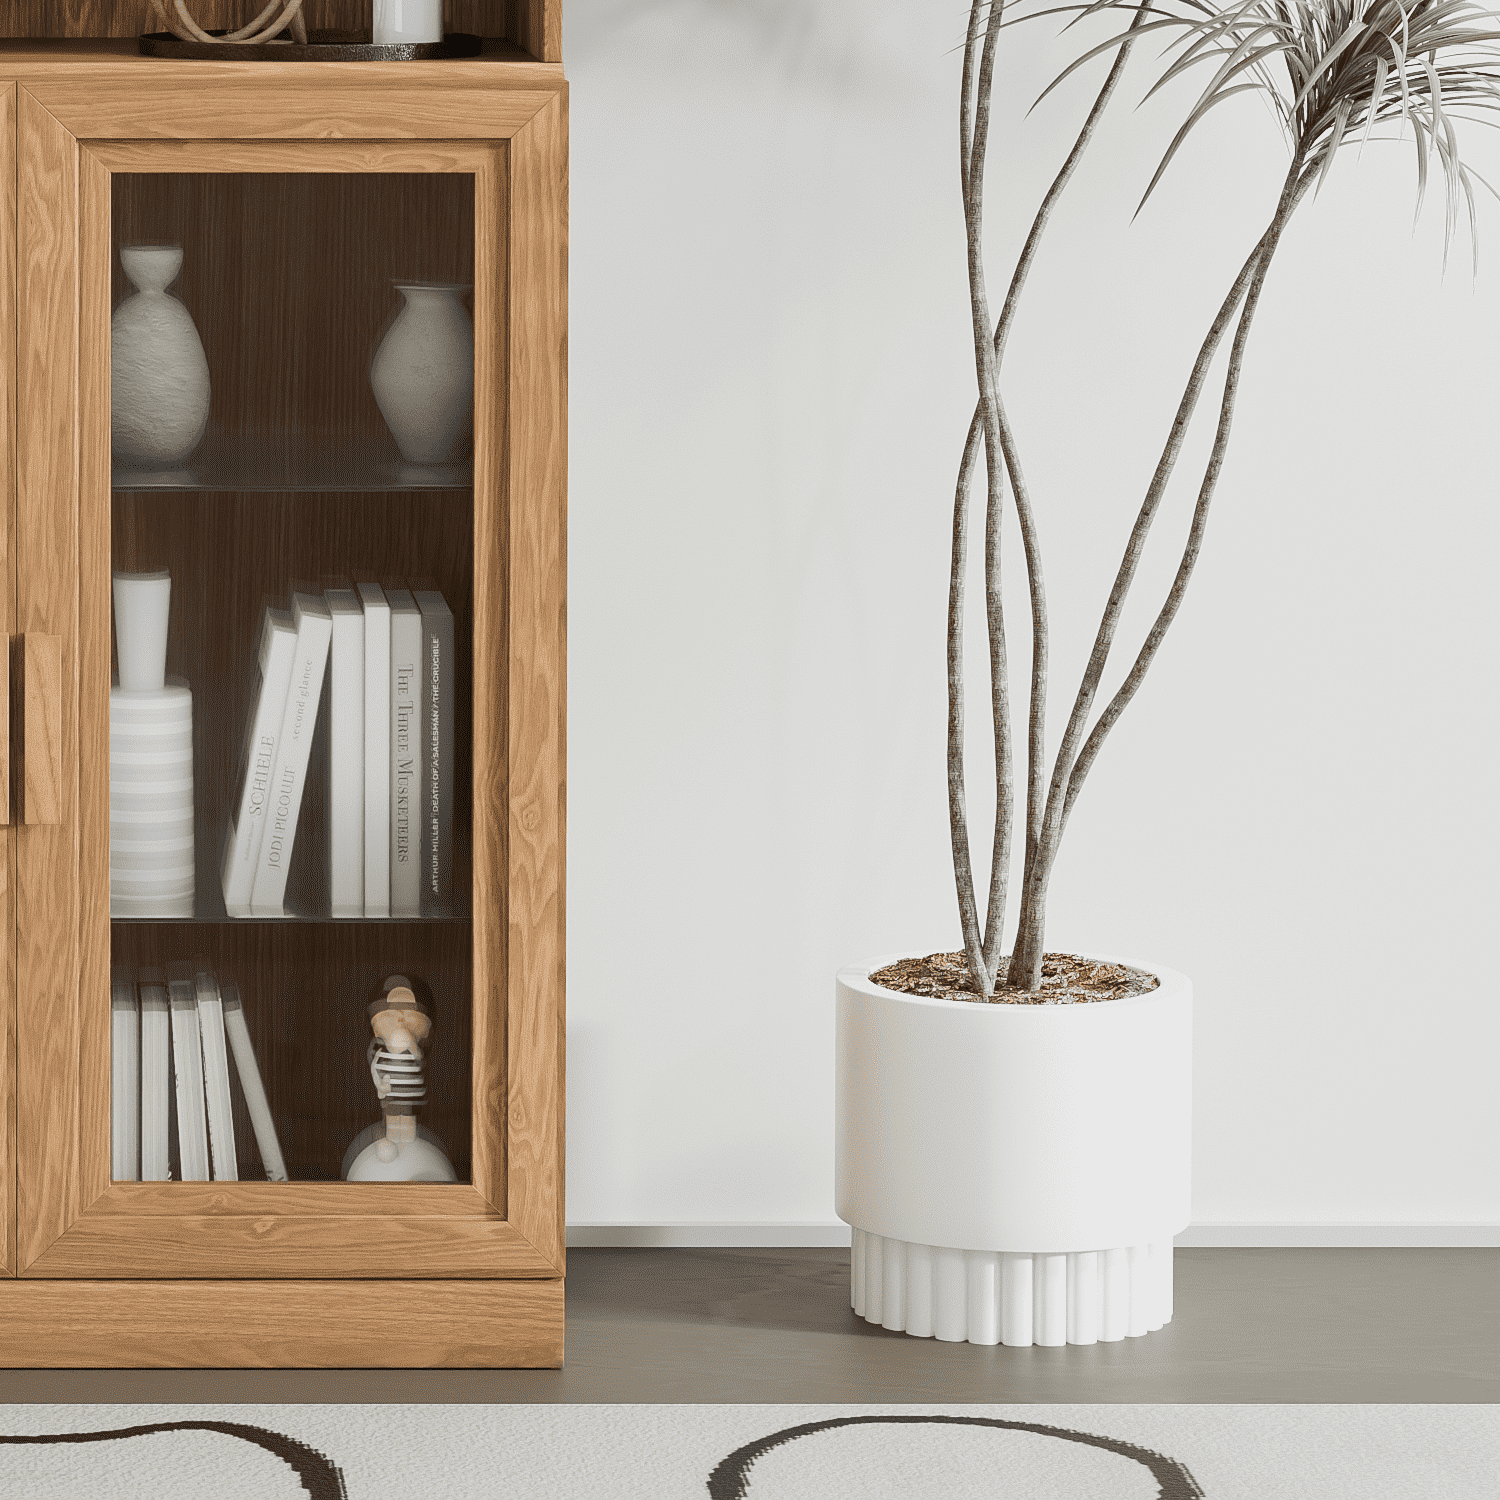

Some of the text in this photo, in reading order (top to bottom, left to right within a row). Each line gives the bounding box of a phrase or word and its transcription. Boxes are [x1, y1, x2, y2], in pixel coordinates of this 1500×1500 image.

[432, 638, 440, 683] CRUCIBLE
[291, 659, 312, 741] second glance
[432, 684, 440, 702] THE
[432, 710, 440, 758] SALESMAN
[250, 735, 275, 816] SCHIELE
[397, 664, 414, 863] THE THREE MUSKETEERS
[432, 767, 440, 780] OF
[268, 766, 295, 869] JODI PICOULT
[432, 782, 440, 812] DEATH
[432, 818, 440, 852] MILLER
[432, 854, 440, 893] ARTHUR
